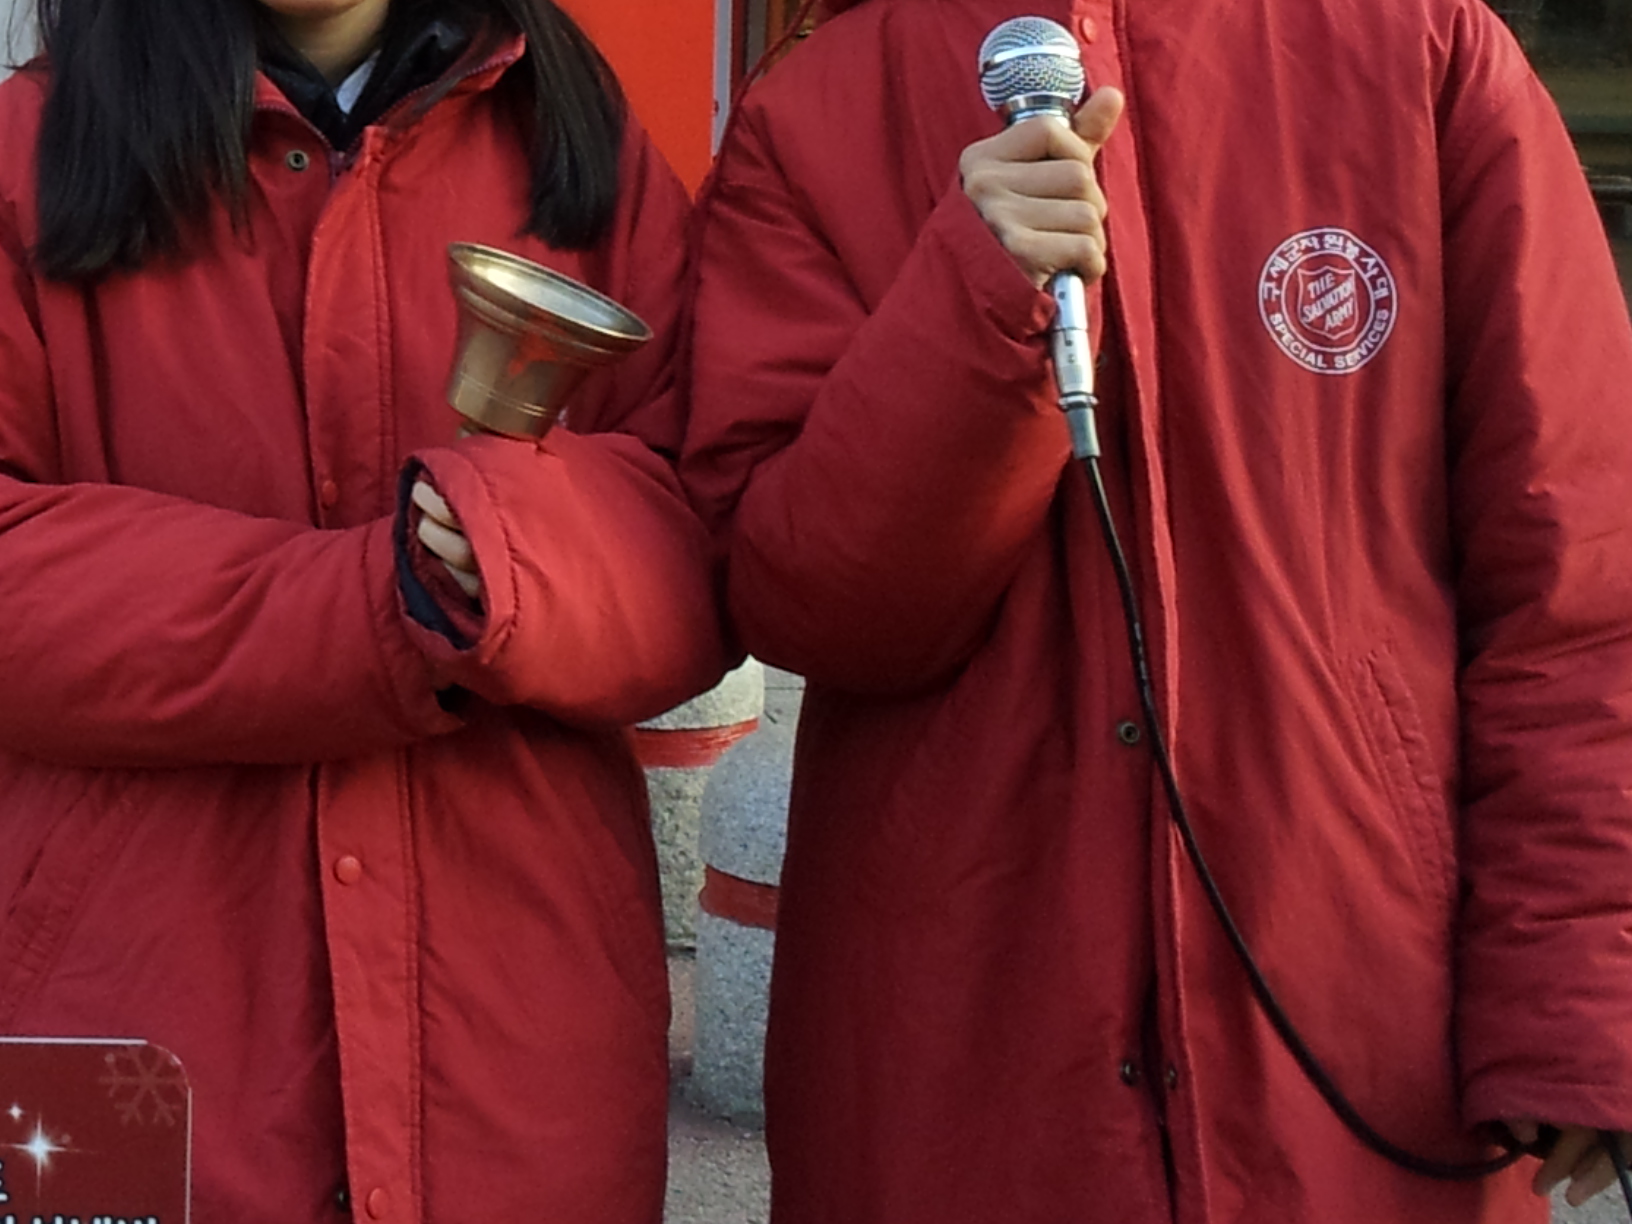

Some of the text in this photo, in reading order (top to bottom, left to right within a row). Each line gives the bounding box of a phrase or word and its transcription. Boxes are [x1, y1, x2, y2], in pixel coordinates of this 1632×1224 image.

[1307, 273, 1336, 298] THE
[1324, 297, 1354, 331] ARMY
[1270, 309, 1389, 368] SPECIAL SERVICES
